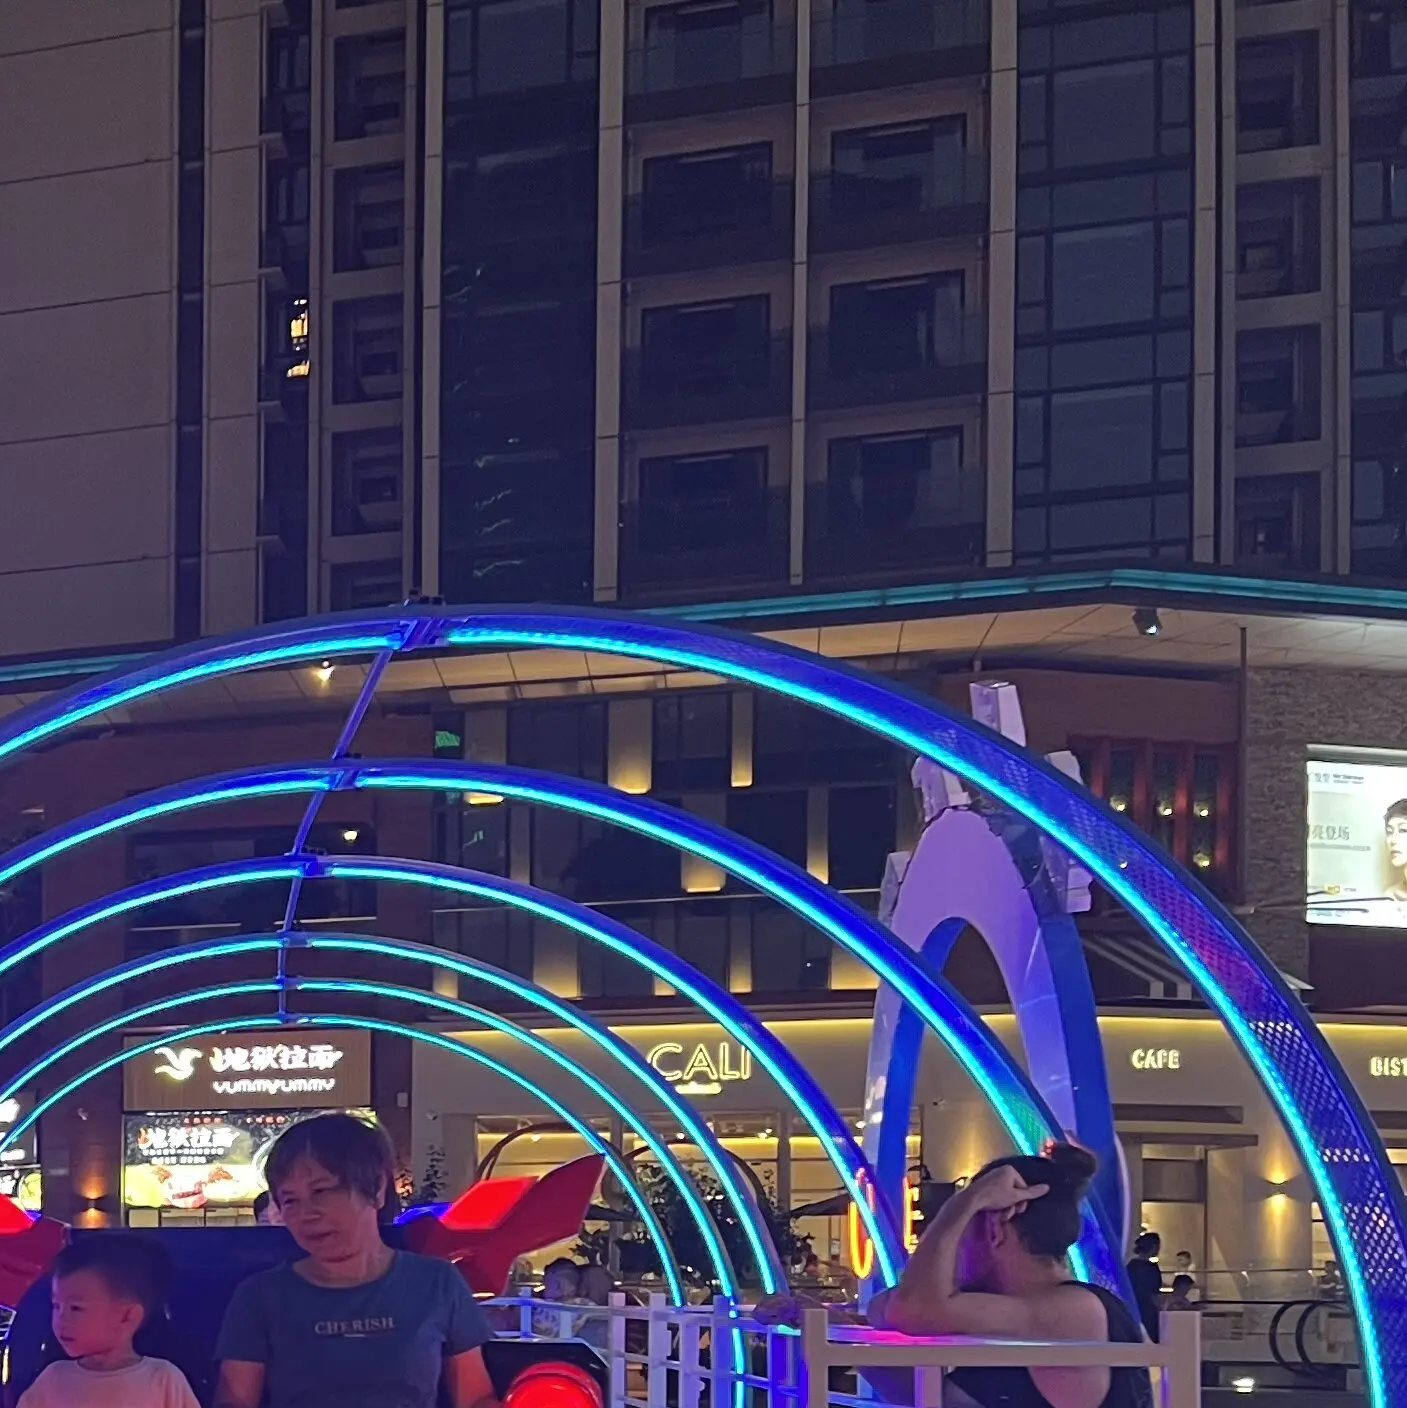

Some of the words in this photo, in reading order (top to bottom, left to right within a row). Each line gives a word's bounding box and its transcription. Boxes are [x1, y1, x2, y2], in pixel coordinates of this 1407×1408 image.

[646, 1042, 752, 1081] CALI
[1131, 1048, 1181, 1069] CAFE
[314, 1317, 396, 1336] CHERISH
